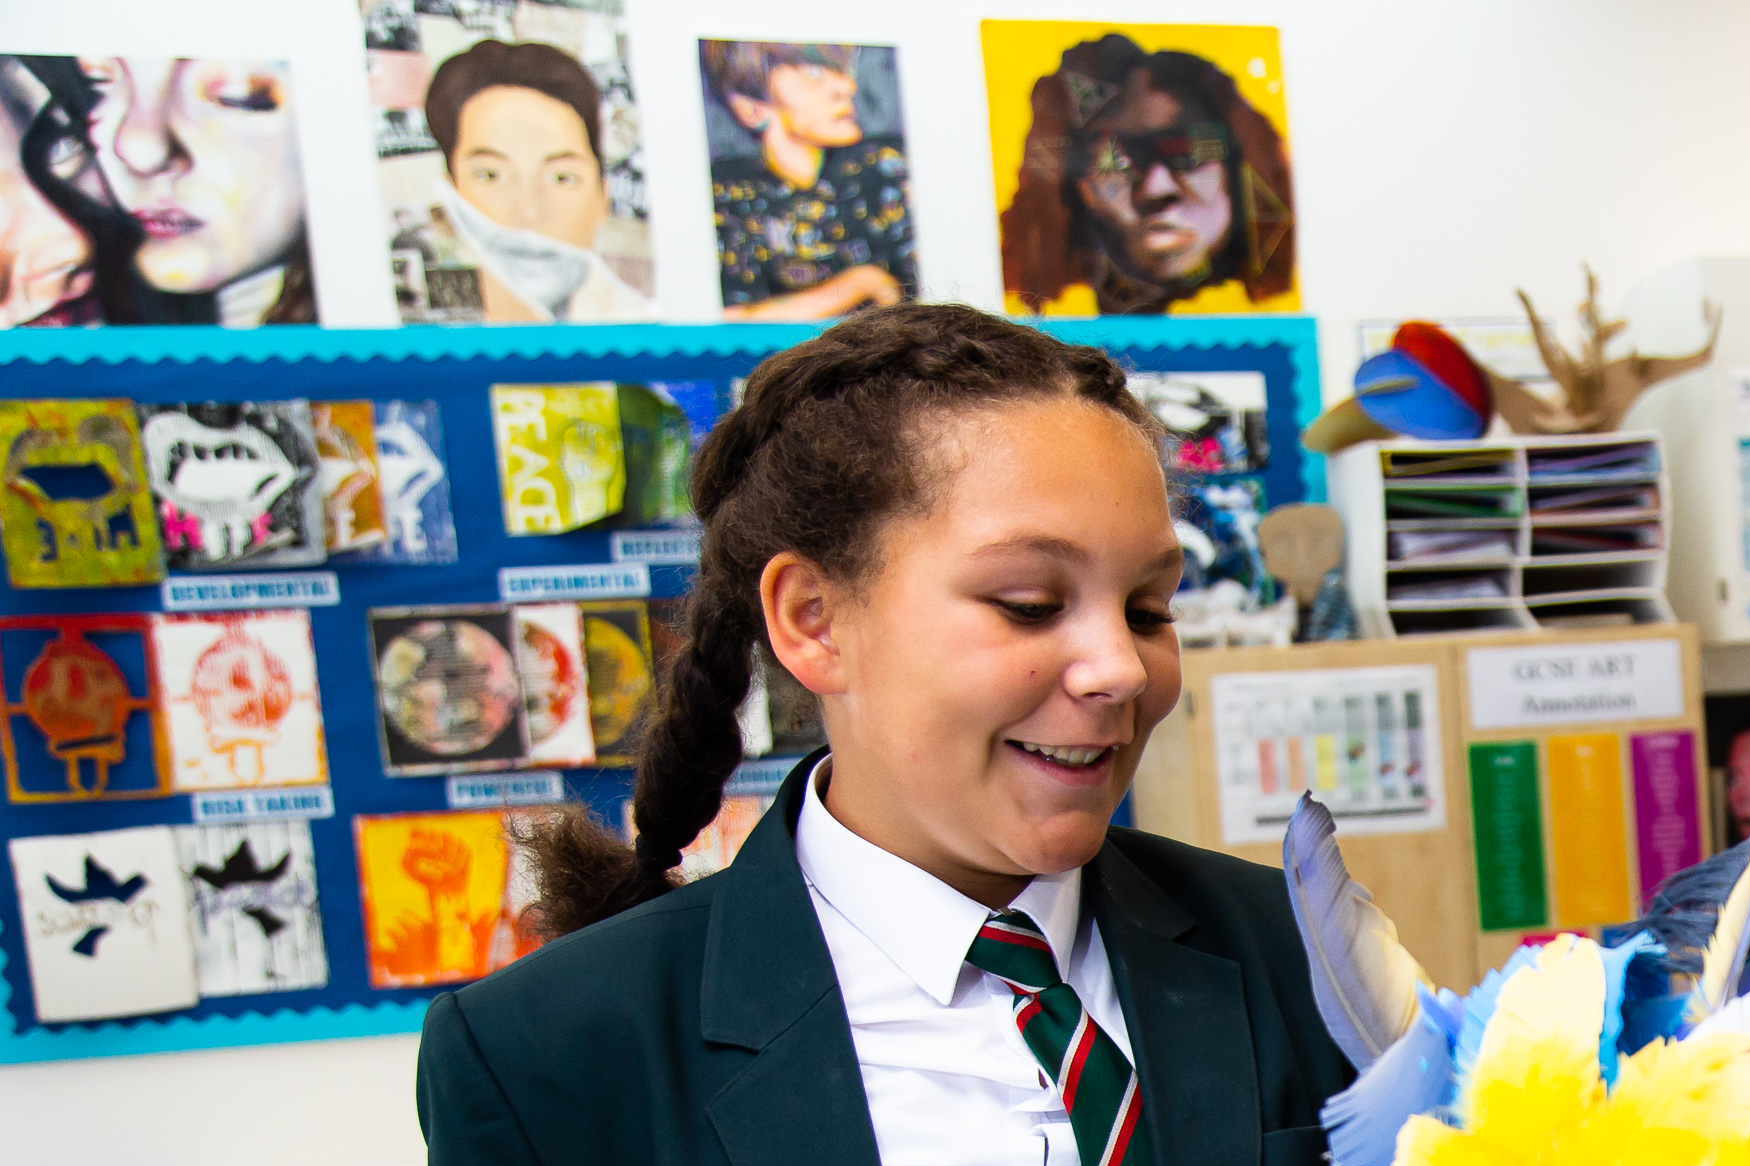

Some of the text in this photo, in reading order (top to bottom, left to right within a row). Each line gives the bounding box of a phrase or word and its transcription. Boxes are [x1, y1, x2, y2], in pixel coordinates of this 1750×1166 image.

[1511, 653, 1635, 681] GCSE ART
[1522, 691, 1637, 714] Annotation
